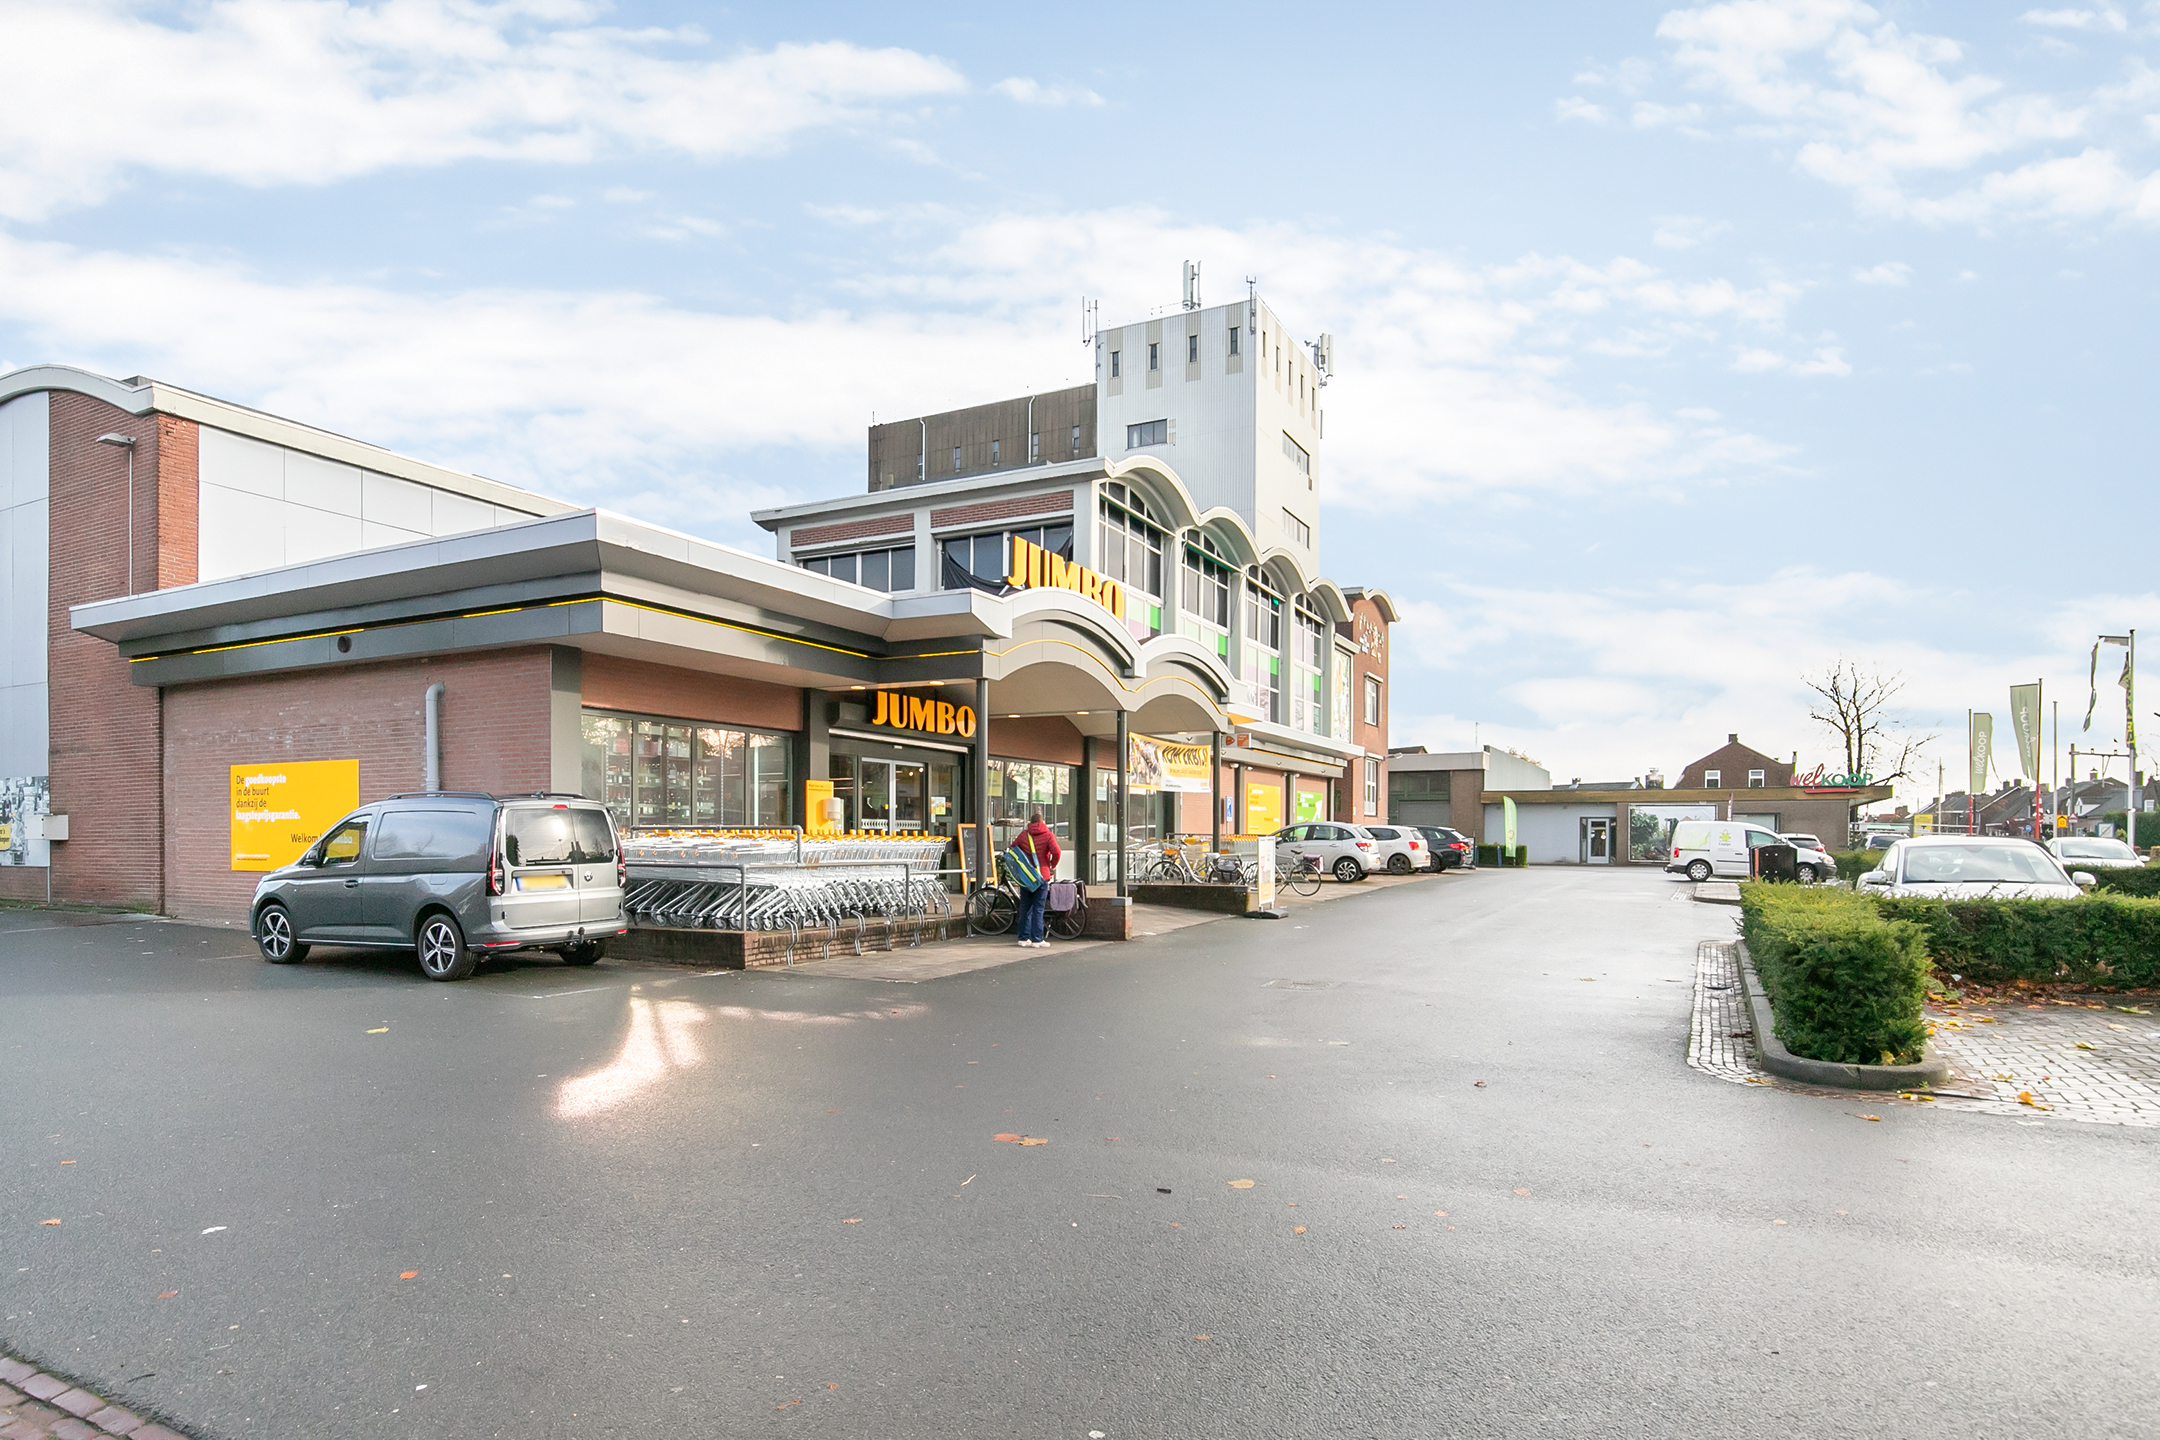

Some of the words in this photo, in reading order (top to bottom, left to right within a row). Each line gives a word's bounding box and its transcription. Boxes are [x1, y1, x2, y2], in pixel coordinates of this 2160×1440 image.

[1007, 535, 1124, 620] JUMBO
[872, 690, 977, 738] JUMBO
[1162, 745, 1185, 764] KOM
[236, 775, 244, 785] De
[245, 773, 287, 787] goedkoopste
[236, 787, 242, 796] in
[243, 787, 251, 796] de
[252, 787, 269, 796] buurt
[236, 798, 258, 810] dankzij
[259, 798, 267, 808] de
[291, 833, 318, 843] Welkom
